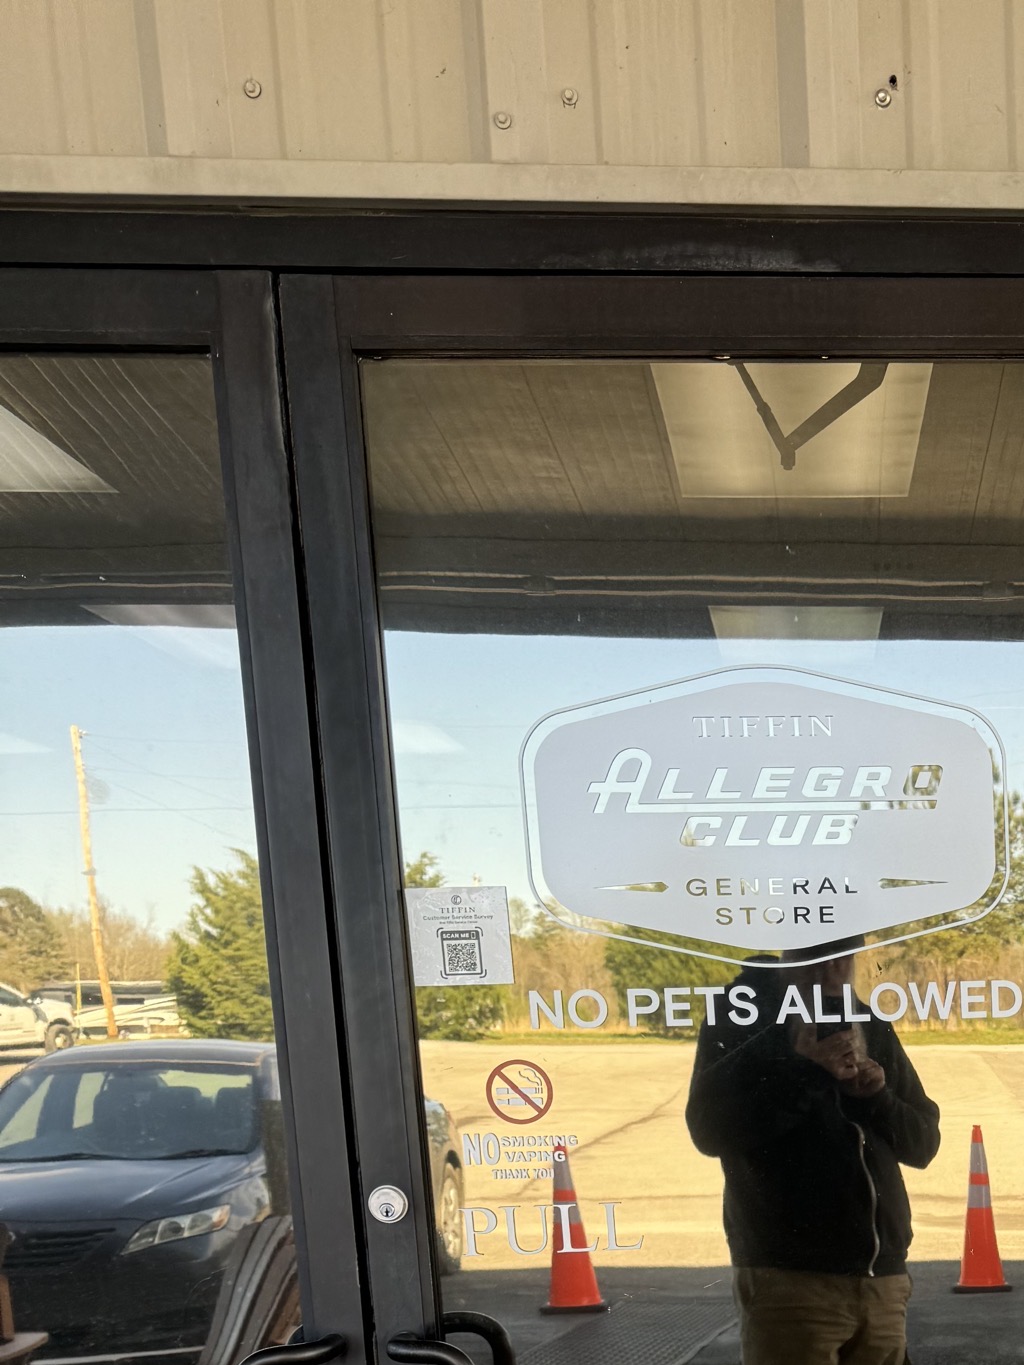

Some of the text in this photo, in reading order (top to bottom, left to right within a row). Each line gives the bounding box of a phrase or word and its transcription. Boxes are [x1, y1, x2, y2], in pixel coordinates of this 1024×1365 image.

[692, 714, 834, 740] TIFFIN
[586, 748, 944, 814] ALLEGRO
[679, 814, 859, 848] CLUB
[685, 875, 860, 899] GENERAL
[716, 905, 836, 928] STORE
[528, 980, 1024, 1030] NO PETS ALLOWED
[462, 1132, 578, 1166] NO SMOKING
[504, 1150, 566, 1162] VAPING
[492, 1168, 555, 1180] THANK YOU
[458, 1201, 644, 1257] PULL
